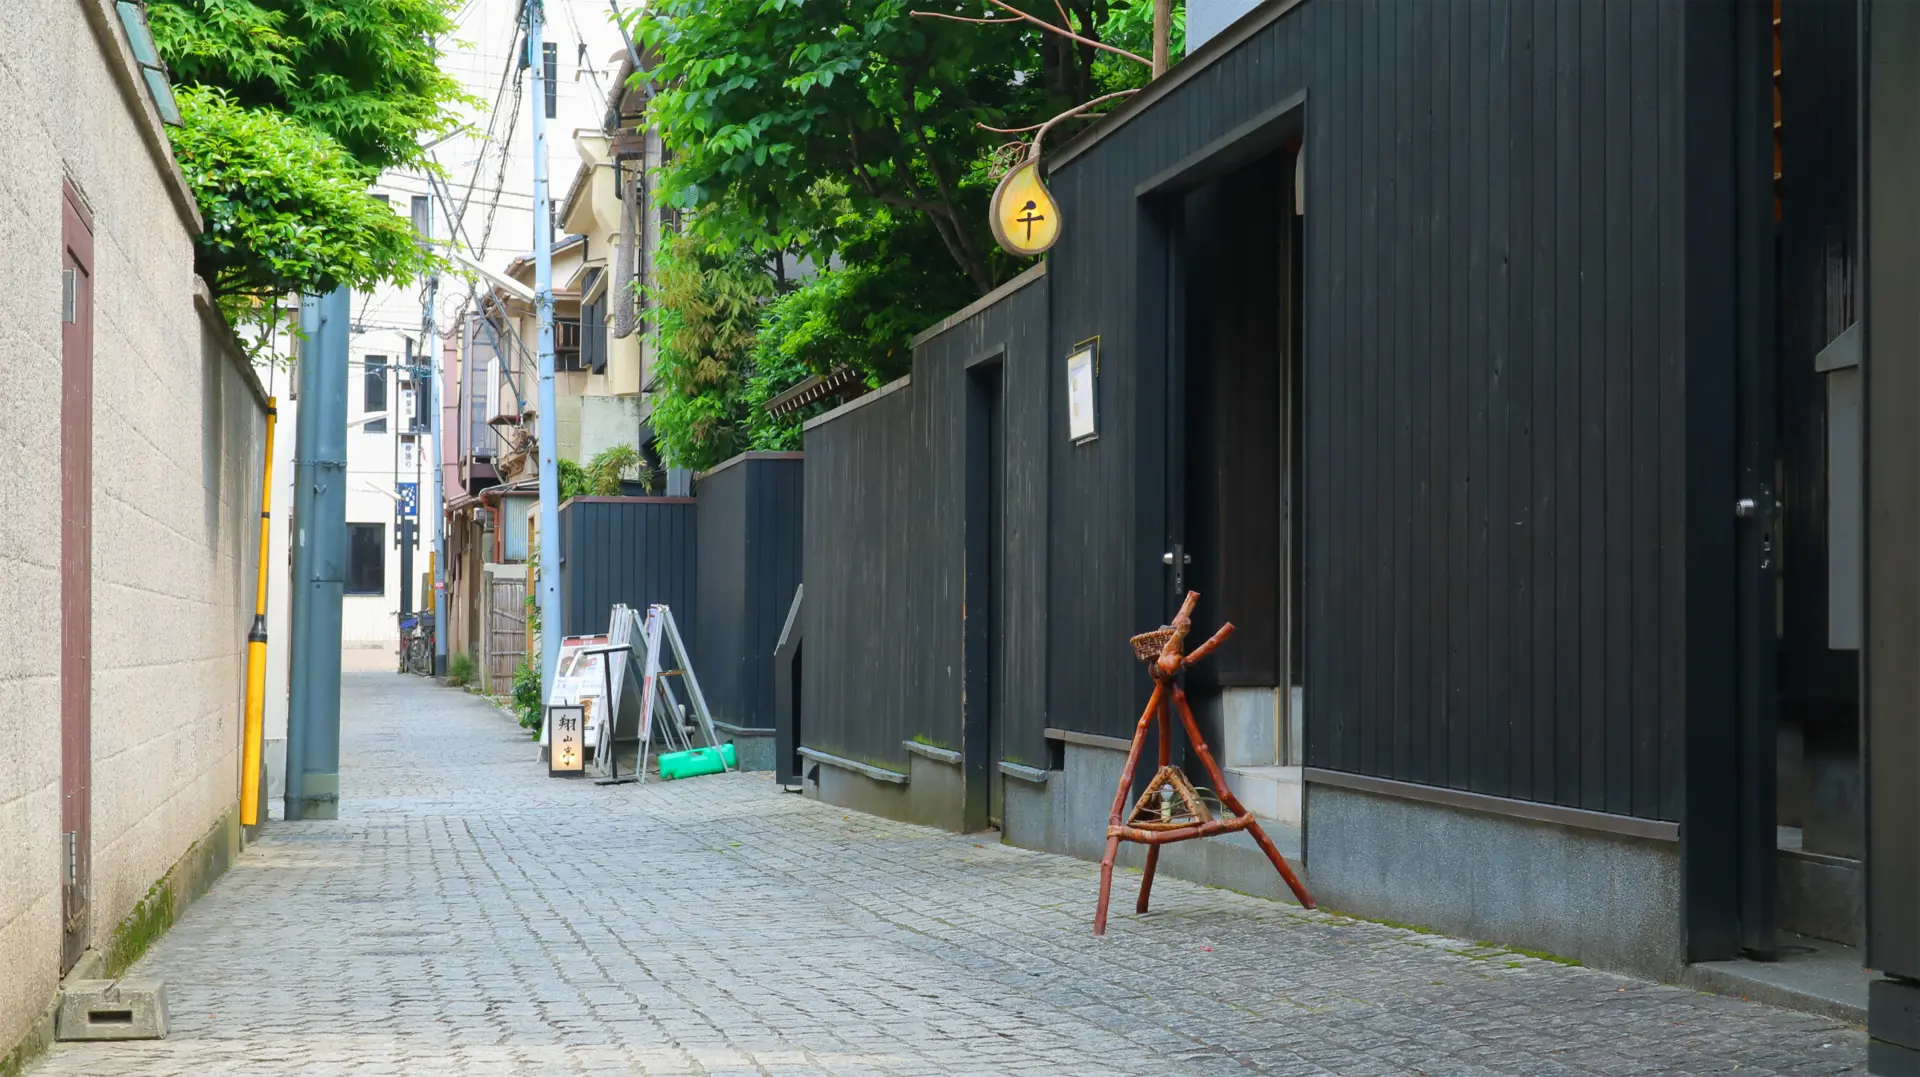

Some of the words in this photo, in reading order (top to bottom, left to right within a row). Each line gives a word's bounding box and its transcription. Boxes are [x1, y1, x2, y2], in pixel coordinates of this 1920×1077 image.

[1016, 200, 1044, 242] 千
[558, 714, 577, 766] 翔山亭
